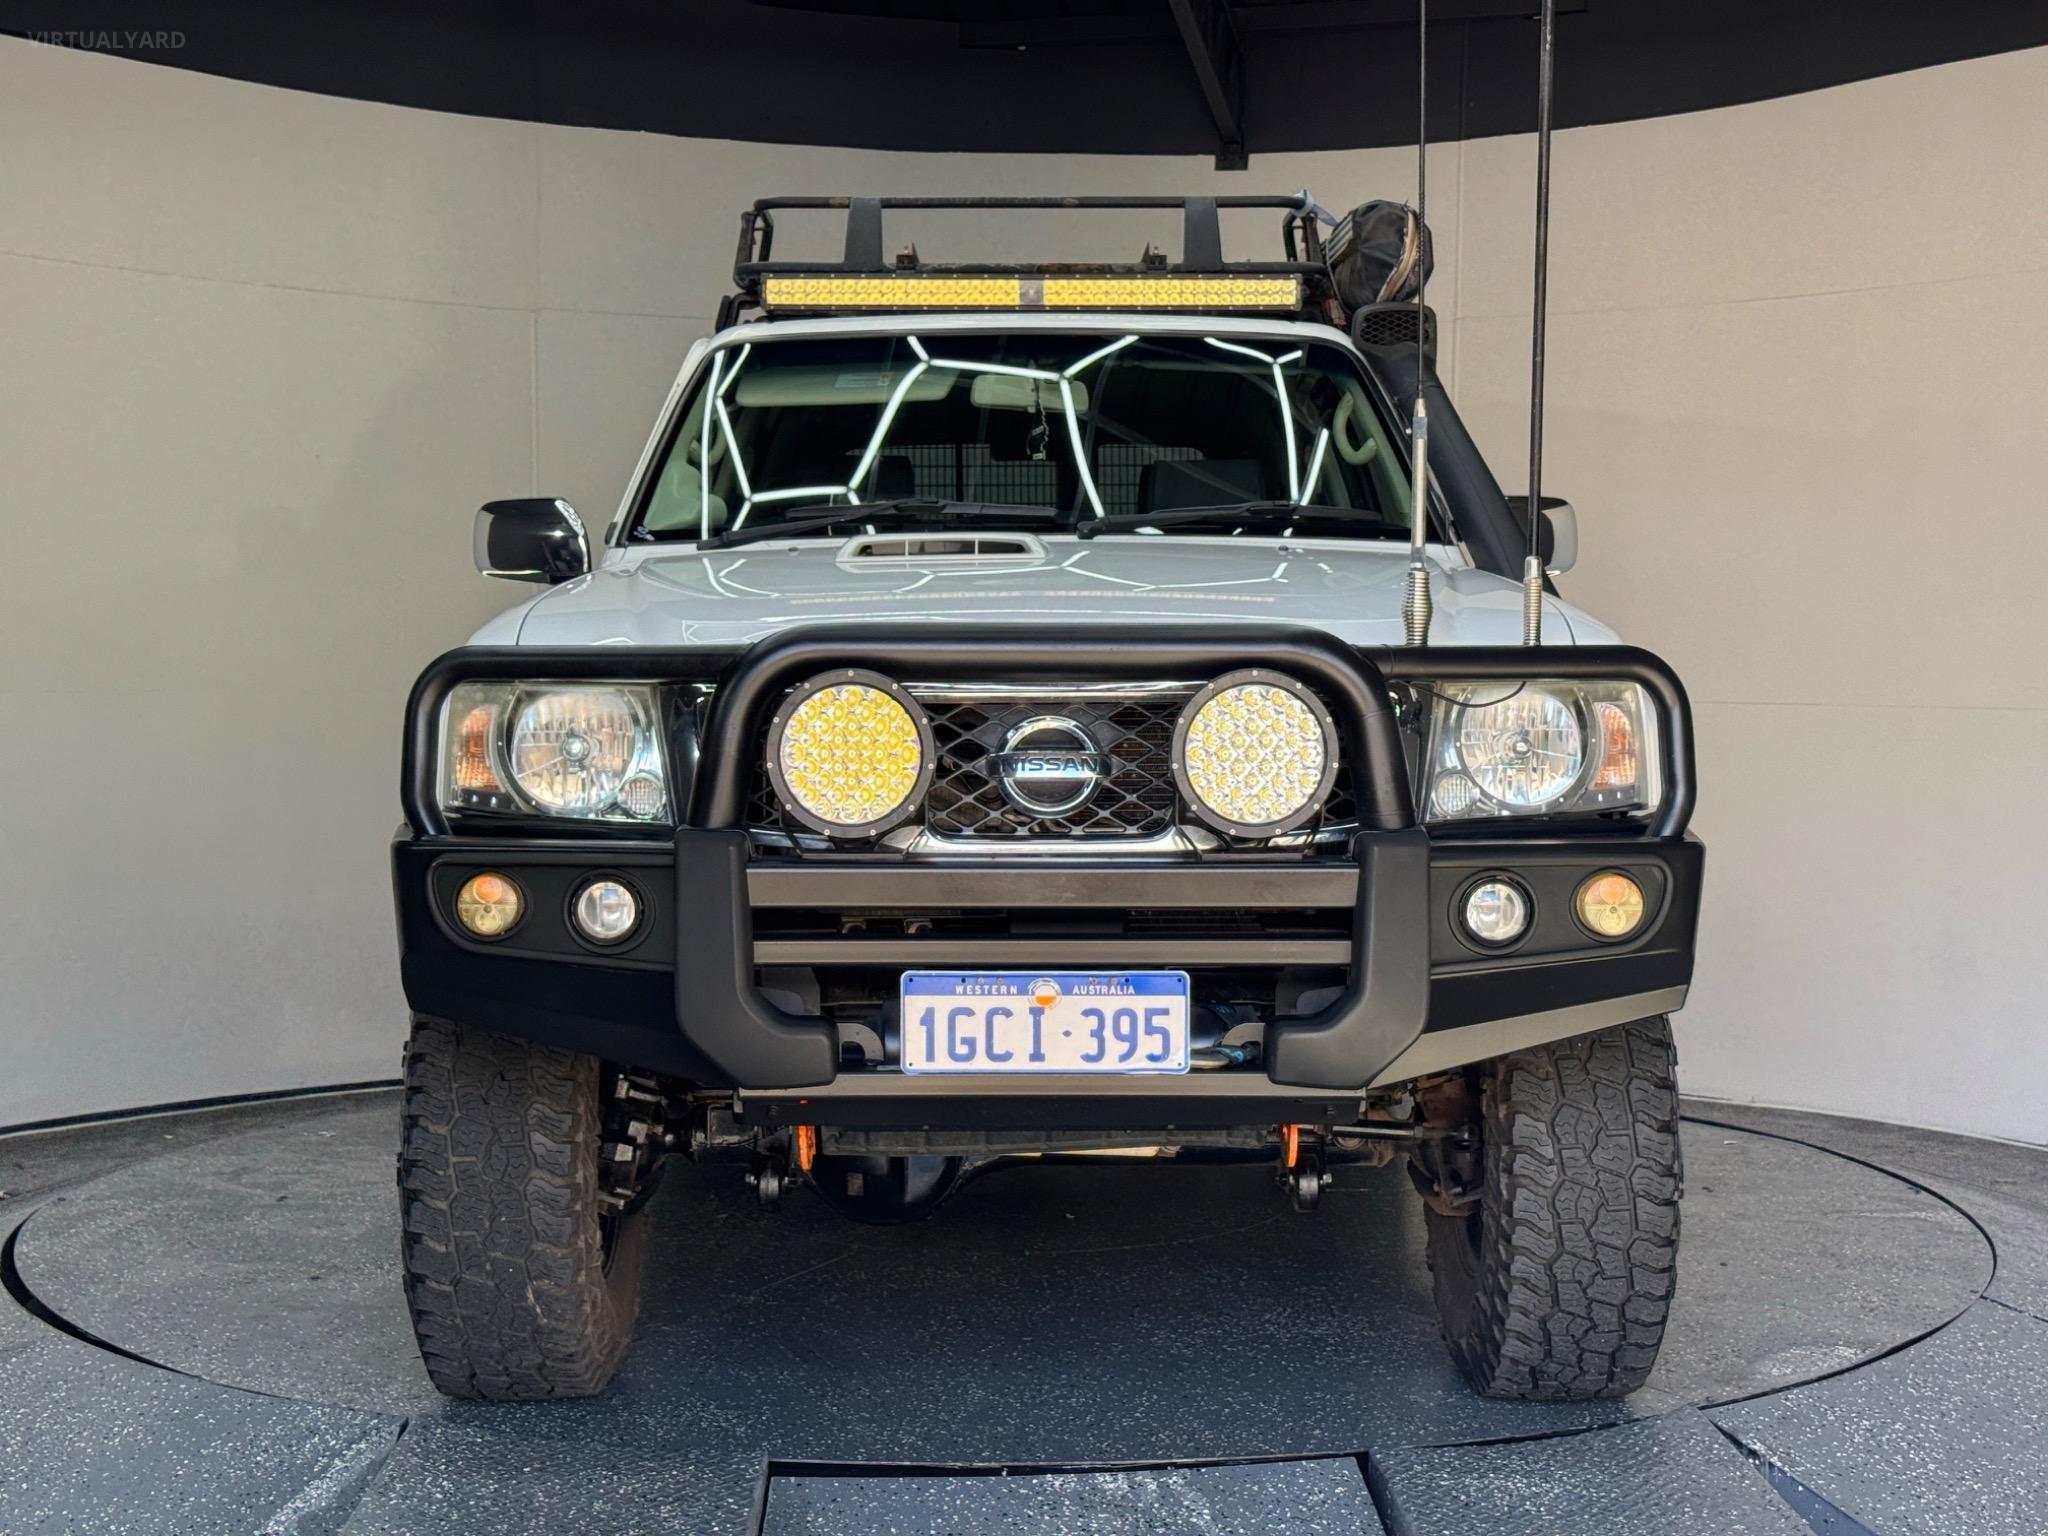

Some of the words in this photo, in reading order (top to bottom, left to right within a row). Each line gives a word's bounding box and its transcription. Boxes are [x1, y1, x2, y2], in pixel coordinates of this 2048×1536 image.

[1001, 756, 1098, 772] NISSAN
[955, 985, 1018, 995] WESTERN
[1072, 984, 1136, 995] AUSTRALIA
